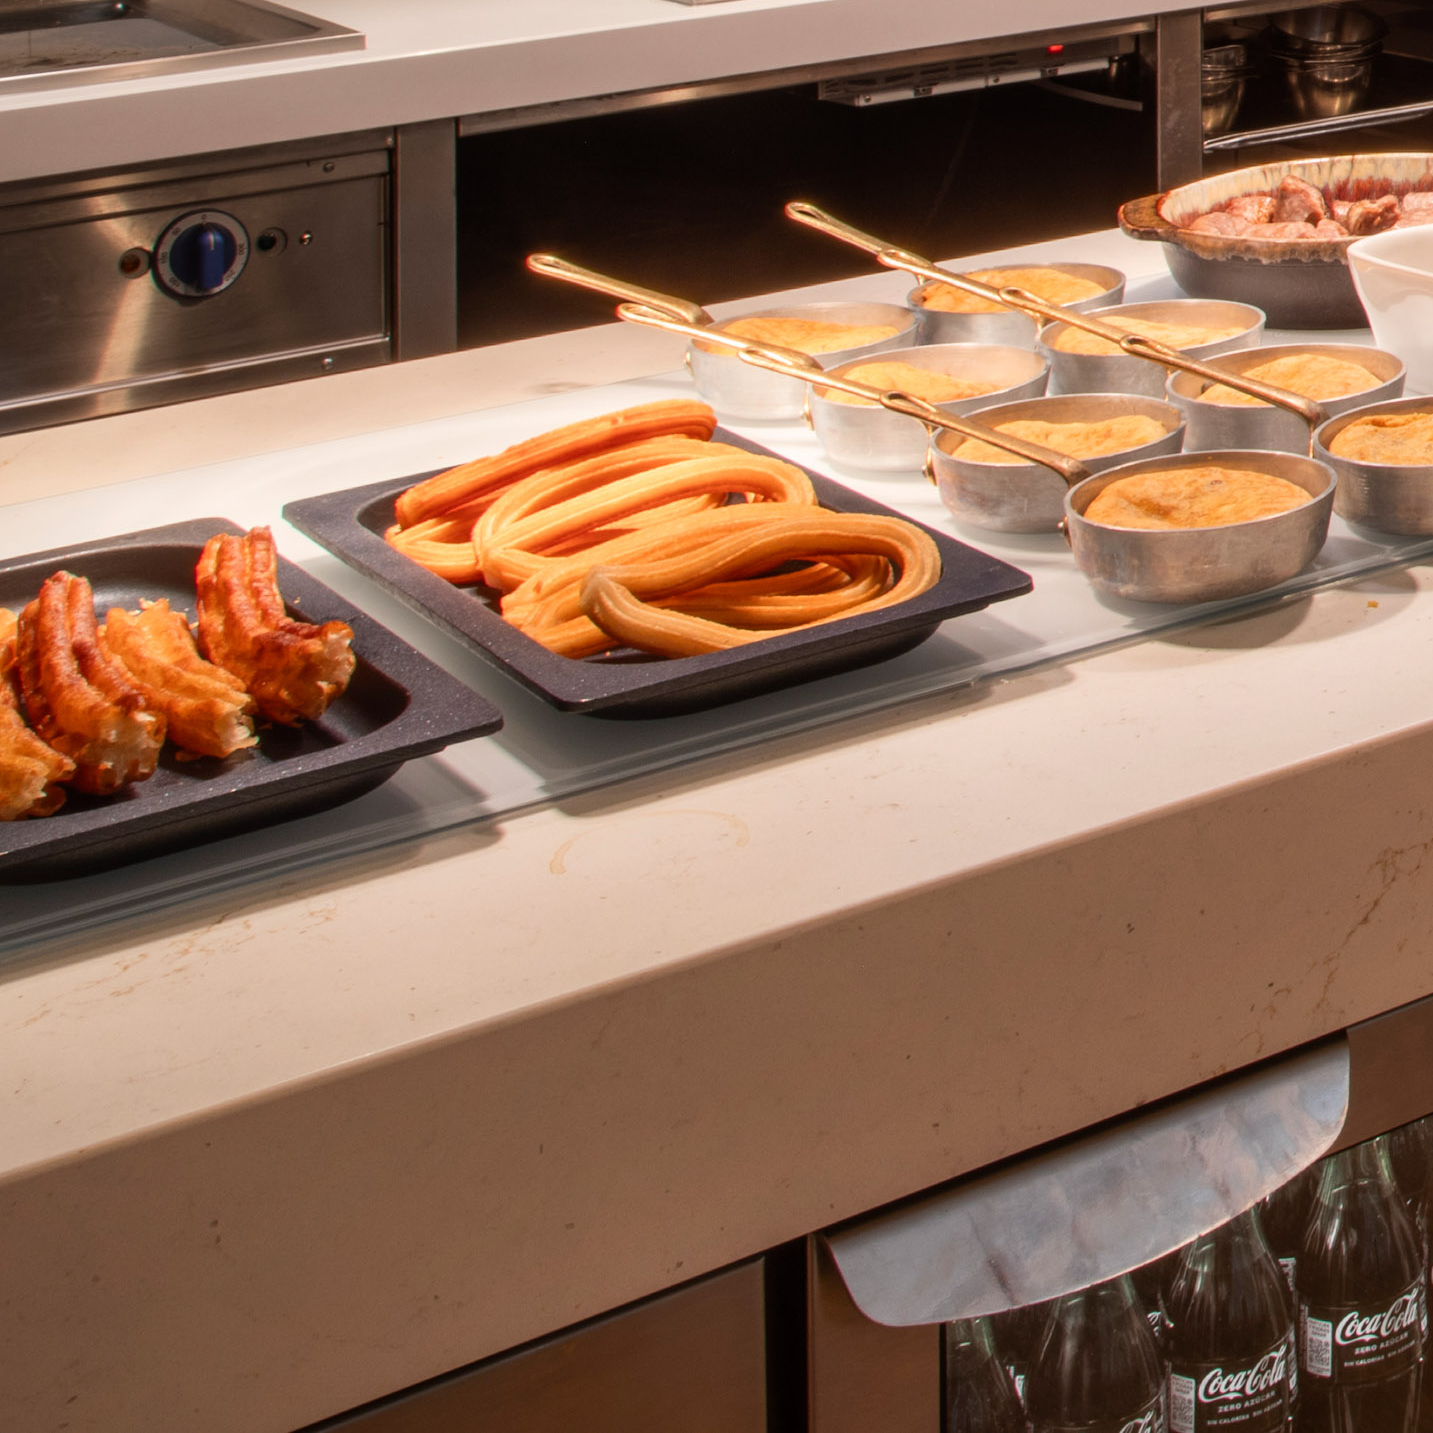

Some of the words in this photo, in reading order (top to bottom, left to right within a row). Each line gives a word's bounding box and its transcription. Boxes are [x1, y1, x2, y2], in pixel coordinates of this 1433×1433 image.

[1335, 1287, 1418, 1345] Coca-Cola
[1354, 1344, 1377, 1355] ZERO
[1198, 1343, 1287, 1404] Coca-Cola
[1218, 1402, 1242, 1413] ZERO
